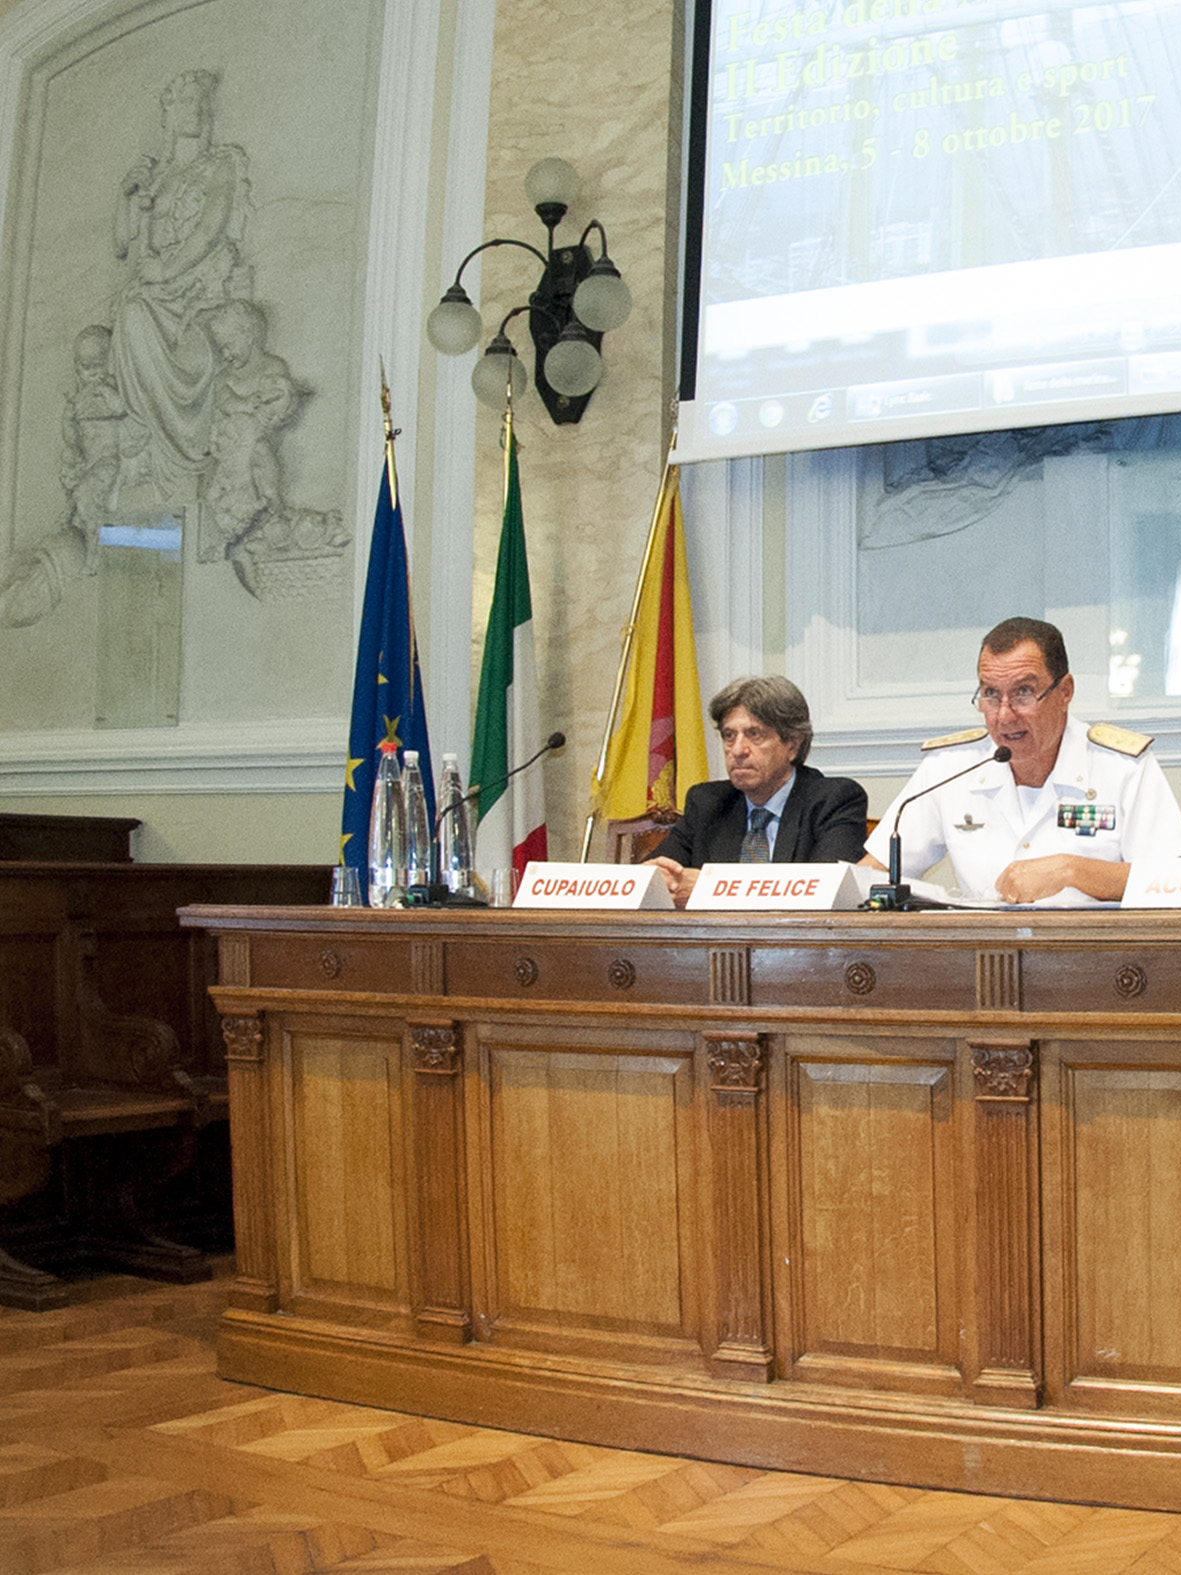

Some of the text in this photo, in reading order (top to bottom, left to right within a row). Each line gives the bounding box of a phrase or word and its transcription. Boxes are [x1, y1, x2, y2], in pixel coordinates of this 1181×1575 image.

[727, 10, 829, 53] Festa
[724, 31, 960, 101] II Edizione
[722, 53, 1129, 144] Territorio, cultura e sport
[719, 149, 850, 191] Messina,
[859, 135, 879, 170] 5
[911, 129, 931, 160] 8
[941, 112, 1060, 156] ottobre
[1072, 93, 1158, 136] 2017
[531, 878, 636, 897] CUPAIUOLO
[712, 878, 820, 897] DE FELICE
